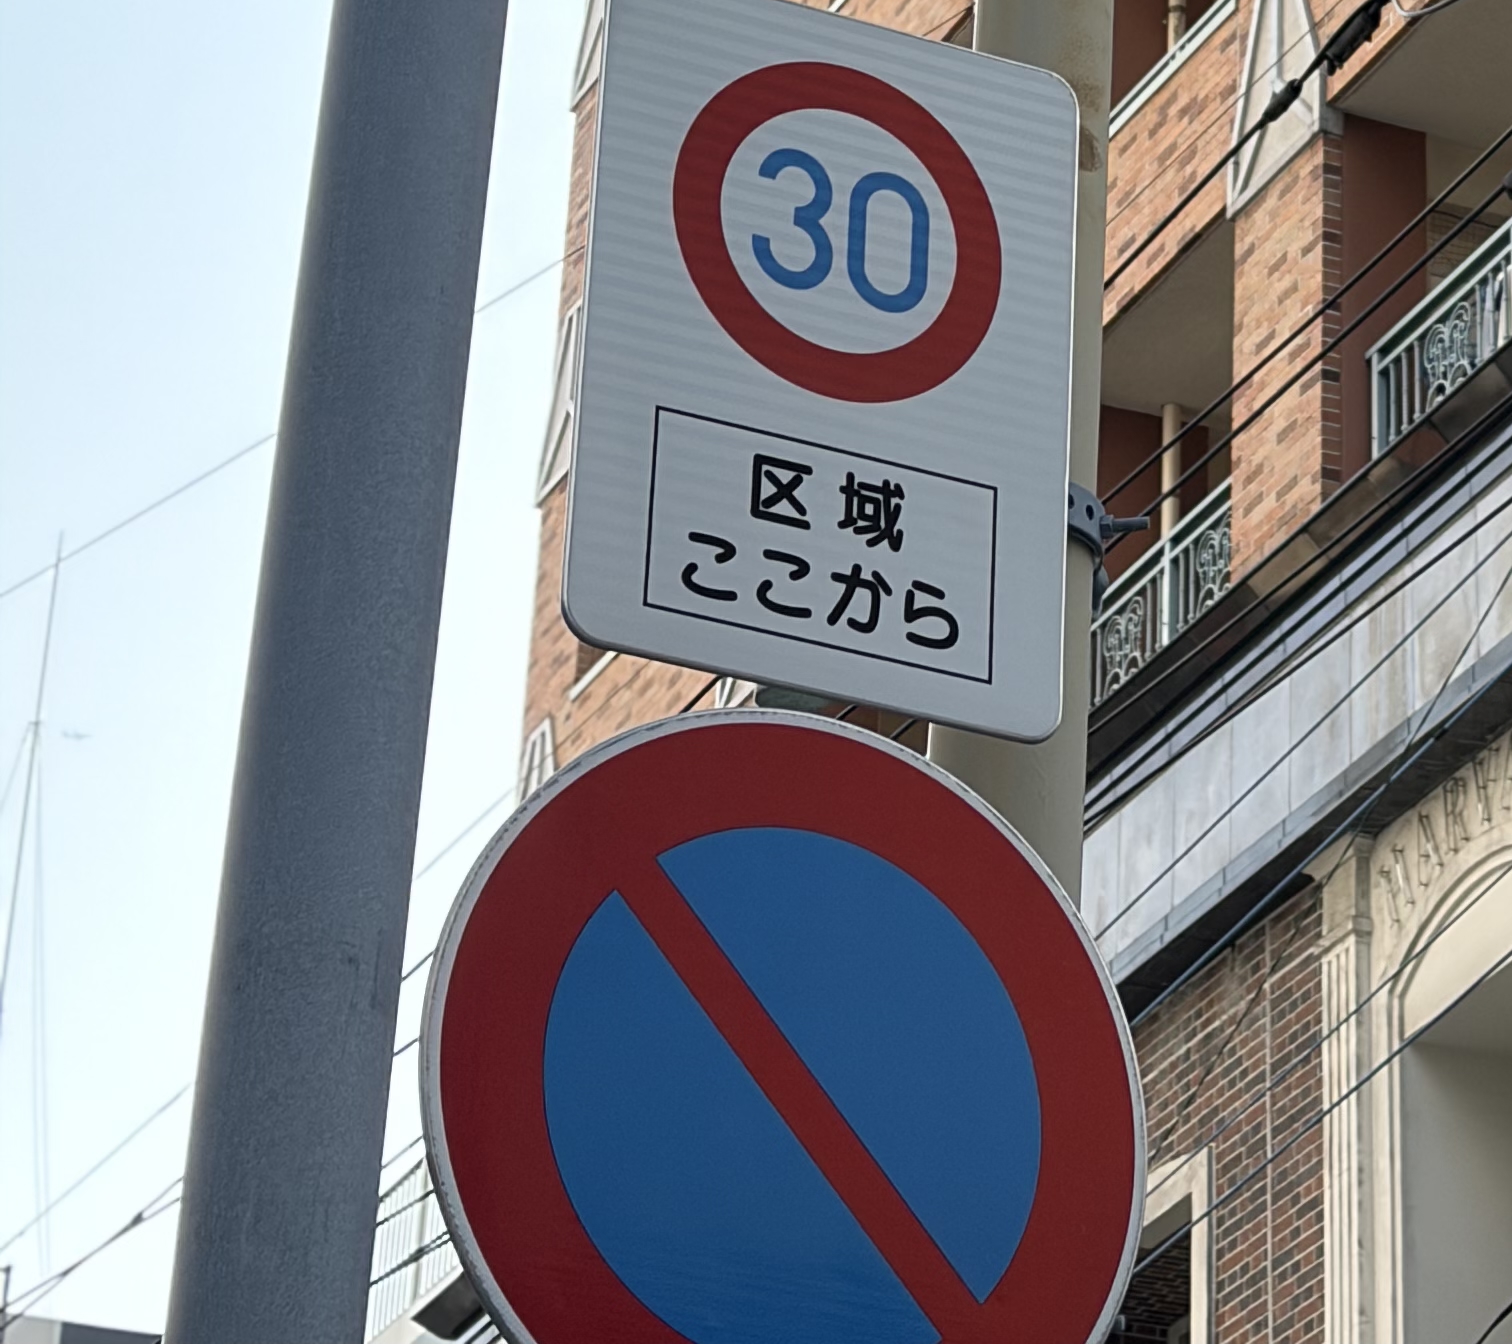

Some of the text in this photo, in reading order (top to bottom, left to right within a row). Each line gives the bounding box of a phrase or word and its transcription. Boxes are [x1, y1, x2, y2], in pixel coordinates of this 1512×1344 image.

[750, 147, 931, 314] 30
[750, 452, 905, 553] 区域
[680, 530, 961, 650] ここから
